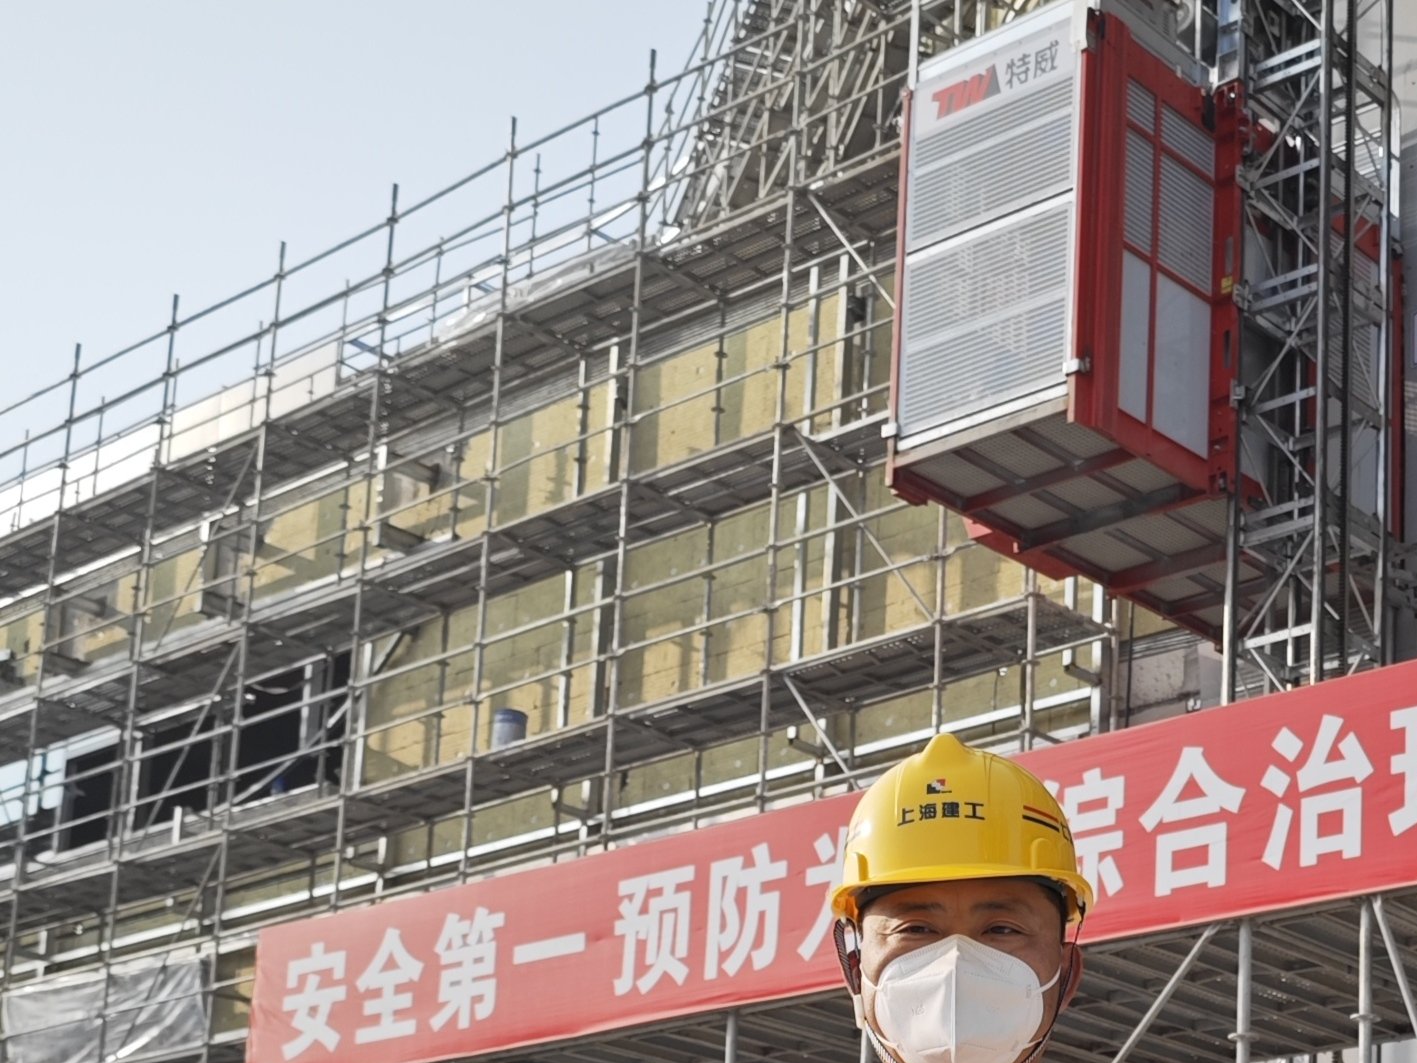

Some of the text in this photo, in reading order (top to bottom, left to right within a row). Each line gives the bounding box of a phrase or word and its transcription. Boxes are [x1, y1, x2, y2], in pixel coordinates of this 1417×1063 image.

[1005, 40, 1059, 89] 特威
[897, 801, 985, 827] 上海建工
[281, 906, 586, 1061] 安全第一
